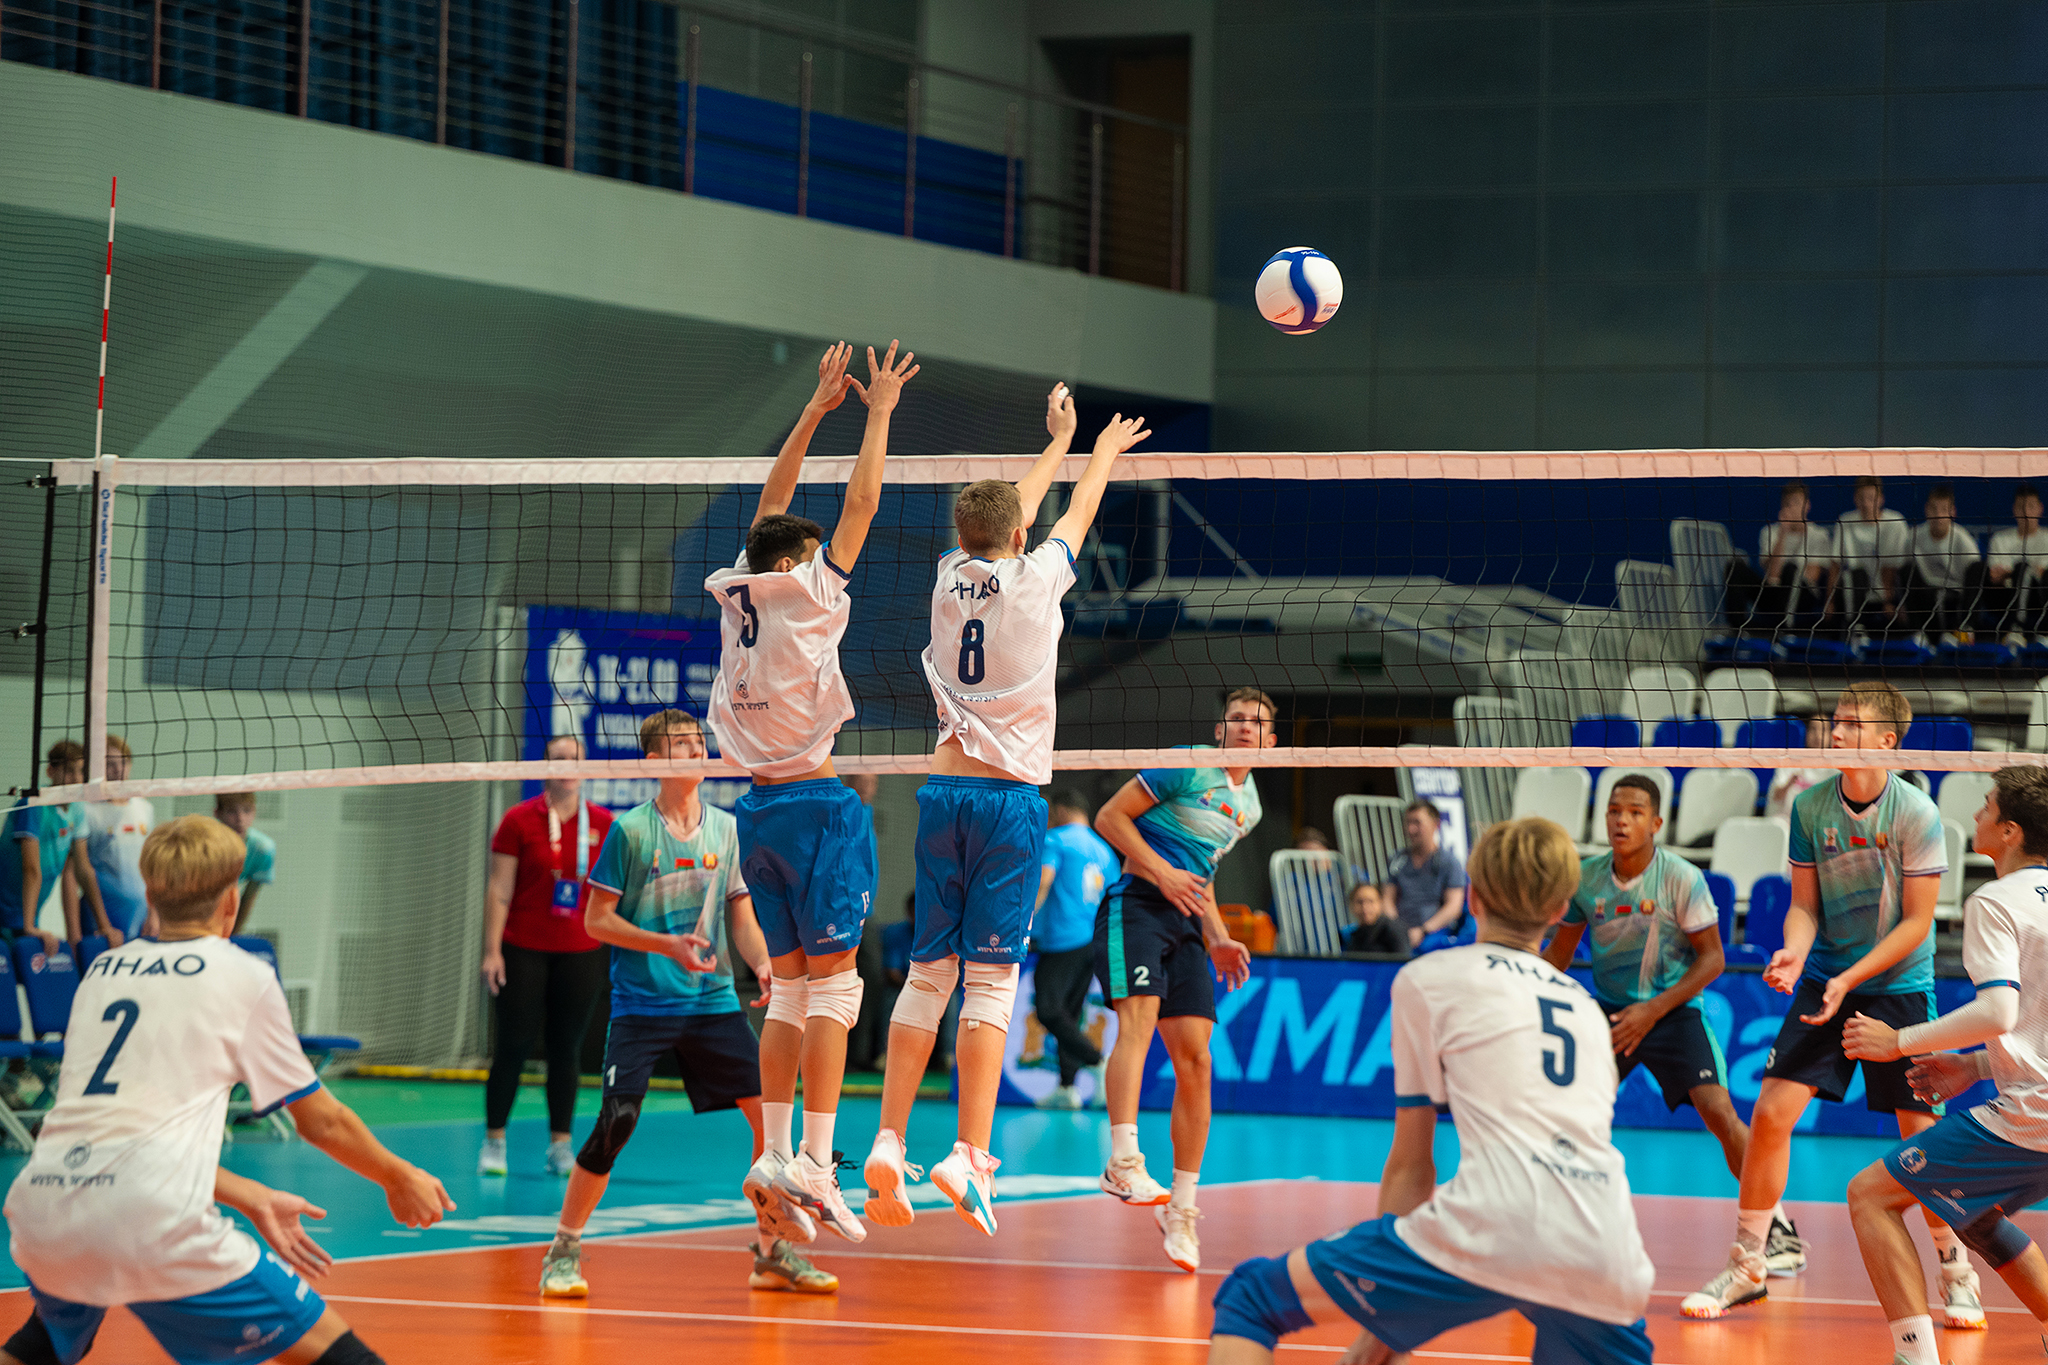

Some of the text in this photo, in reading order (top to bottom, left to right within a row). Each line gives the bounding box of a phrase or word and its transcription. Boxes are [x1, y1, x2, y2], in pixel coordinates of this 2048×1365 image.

[958, 619, 985, 685] 8
[87, 954, 206, 980] ЯНАО
[1133, 965, 1150, 986] 2
[1486, 954, 1594, 997] ЯНА
[82, 998, 140, 1097] 2
[1536, 995, 1576, 1087] 5
[606, 1064, 617, 1087] 1
